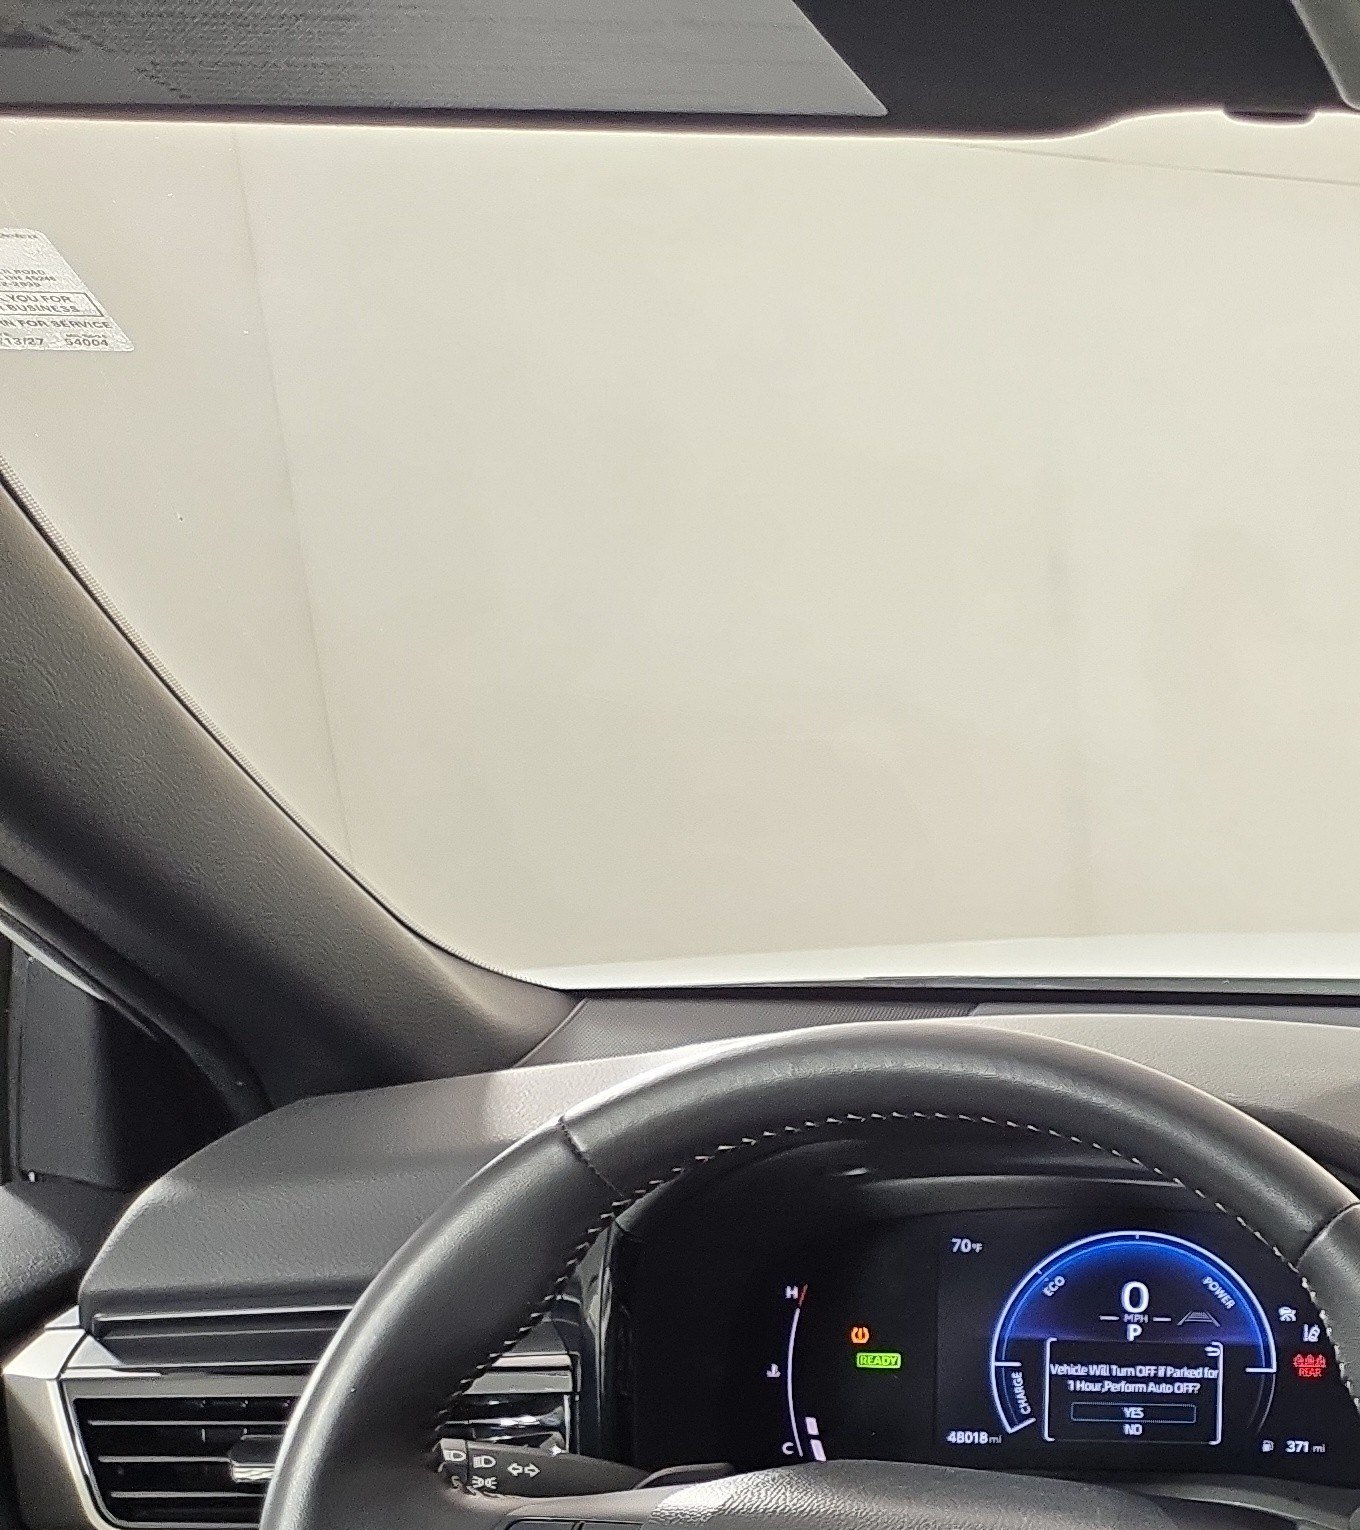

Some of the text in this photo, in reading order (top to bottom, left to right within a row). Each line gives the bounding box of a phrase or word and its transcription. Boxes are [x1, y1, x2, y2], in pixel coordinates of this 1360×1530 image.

[7, 294, 38, 302] YOU
[40, 295, 72, 303] FOR
[7, 304, 80, 313] BUSINESS
[19, 319, 49, 328] FOR
[50, 320, 113, 329] SERVICE
[785, 1285, 799, 1299] H
[1042, 1275, 1236, 1310] ECO POWER
[1121, 1281, 1150, 1313] 0
[1123, 1314, 1149, 1323] MPH
[1126, 1323, 1143, 1341] P
[859, 1354, 899, 1366] READY
[1050, 1363, 1220, 1379] Vehicle Will Turn OFF if Parked for
[1011, 1371, 1032, 1415] CHARGE
[1148, 1382, 1173, 1393] Auto
[1173, 1382, 1201, 1394] OFF?
[1122, 1407, 1144, 1419] YES
[1123, 1424, 1143, 1436] NO
[782, 1441, 794, 1455] C
[1285, 1440, 1309, 1453] 371
